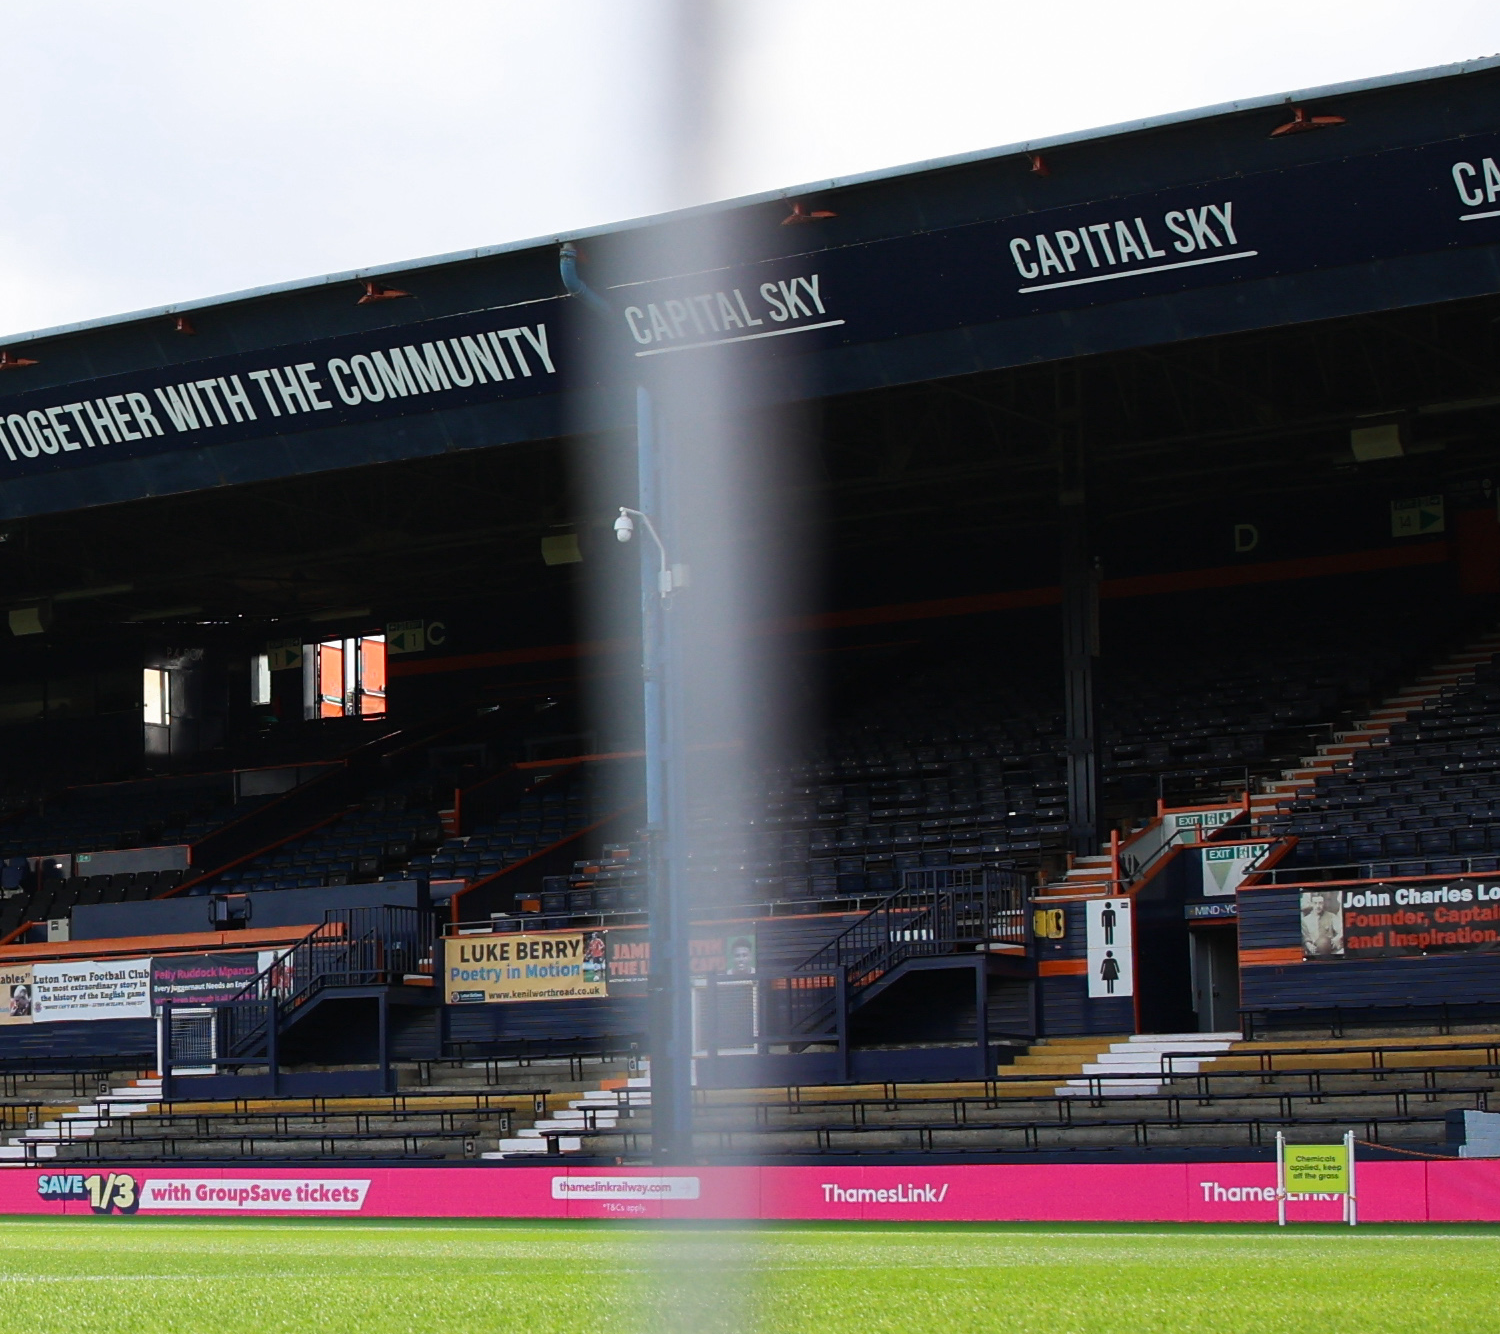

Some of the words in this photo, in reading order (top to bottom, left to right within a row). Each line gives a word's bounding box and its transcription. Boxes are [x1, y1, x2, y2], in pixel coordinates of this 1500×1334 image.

[1009, 217, 1166, 279] CAPITAL
[1164, 201, 1238, 253] SKY
[624, 288, 763, 344] CAPITAL
[759, 274, 826, 323] SKY
[155, 374, 256, 433] WITH
[249, 362, 332, 416] THE
[327, 323, 555, 405] COMMUNITY
[1178, 816, 1199, 825] EXIT
[1209, 849, 1230, 859] EXIT
[1343, 891, 1390, 909] John
[1395, 886, 1473, 905] Charles
[1345, 911, 1430, 930] Founder,
[1347, 932, 1384, 949] and
[460, 943, 510, 963] LUKE
[516, 939, 580, 961] BERRY
[33, 975, 59, 984] Luton
[62, 973, 87, 983] Town
[89, 971, 126, 982] Football
[128, 969, 150, 980] Club
[155, 969, 176, 981] Pelly
[177, 967, 217, 979] Ruddock
[219, 966, 255, 979] Mpanzu
[451, 967, 501, 983] Poetry
[507, 963, 521, 979] in
[525, 963, 580, 978] Motion
[38, 985, 50, 993] The
[70, 982, 118, 992] extraordinary
[120, 981, 138, 990] story
[139, 980, 147, 988] in
[489, 986, 600, 999] www.kenilworthroad.co.uk
[41, 994, 51, 1002] the
[53, 993, 78, 1005] history
[79, 992, 87, 1000] of
[87, 992, 99, 1000] the
[101, 991, 126, 1001] English
[127, 991, 146, 1000] game
[1296, 1155, 1336, 1163] Chemicals
[1289, 1164, 1321, 1172] applied,
[1323, 1164, 1342, 1172] keep
[1318, 1173, 1339, 1181] grass
[37, 1174, 83, 1195] SAVE
[85, 1174, 136, 1210] 1/3
[151, 1182, 192, 1203] with
[195, 1182, 293, 1208] GroupSave
[296, 1181, 360, 1204] tickets
[559, 1180, 671, 1196] thameslinkrailway.com
